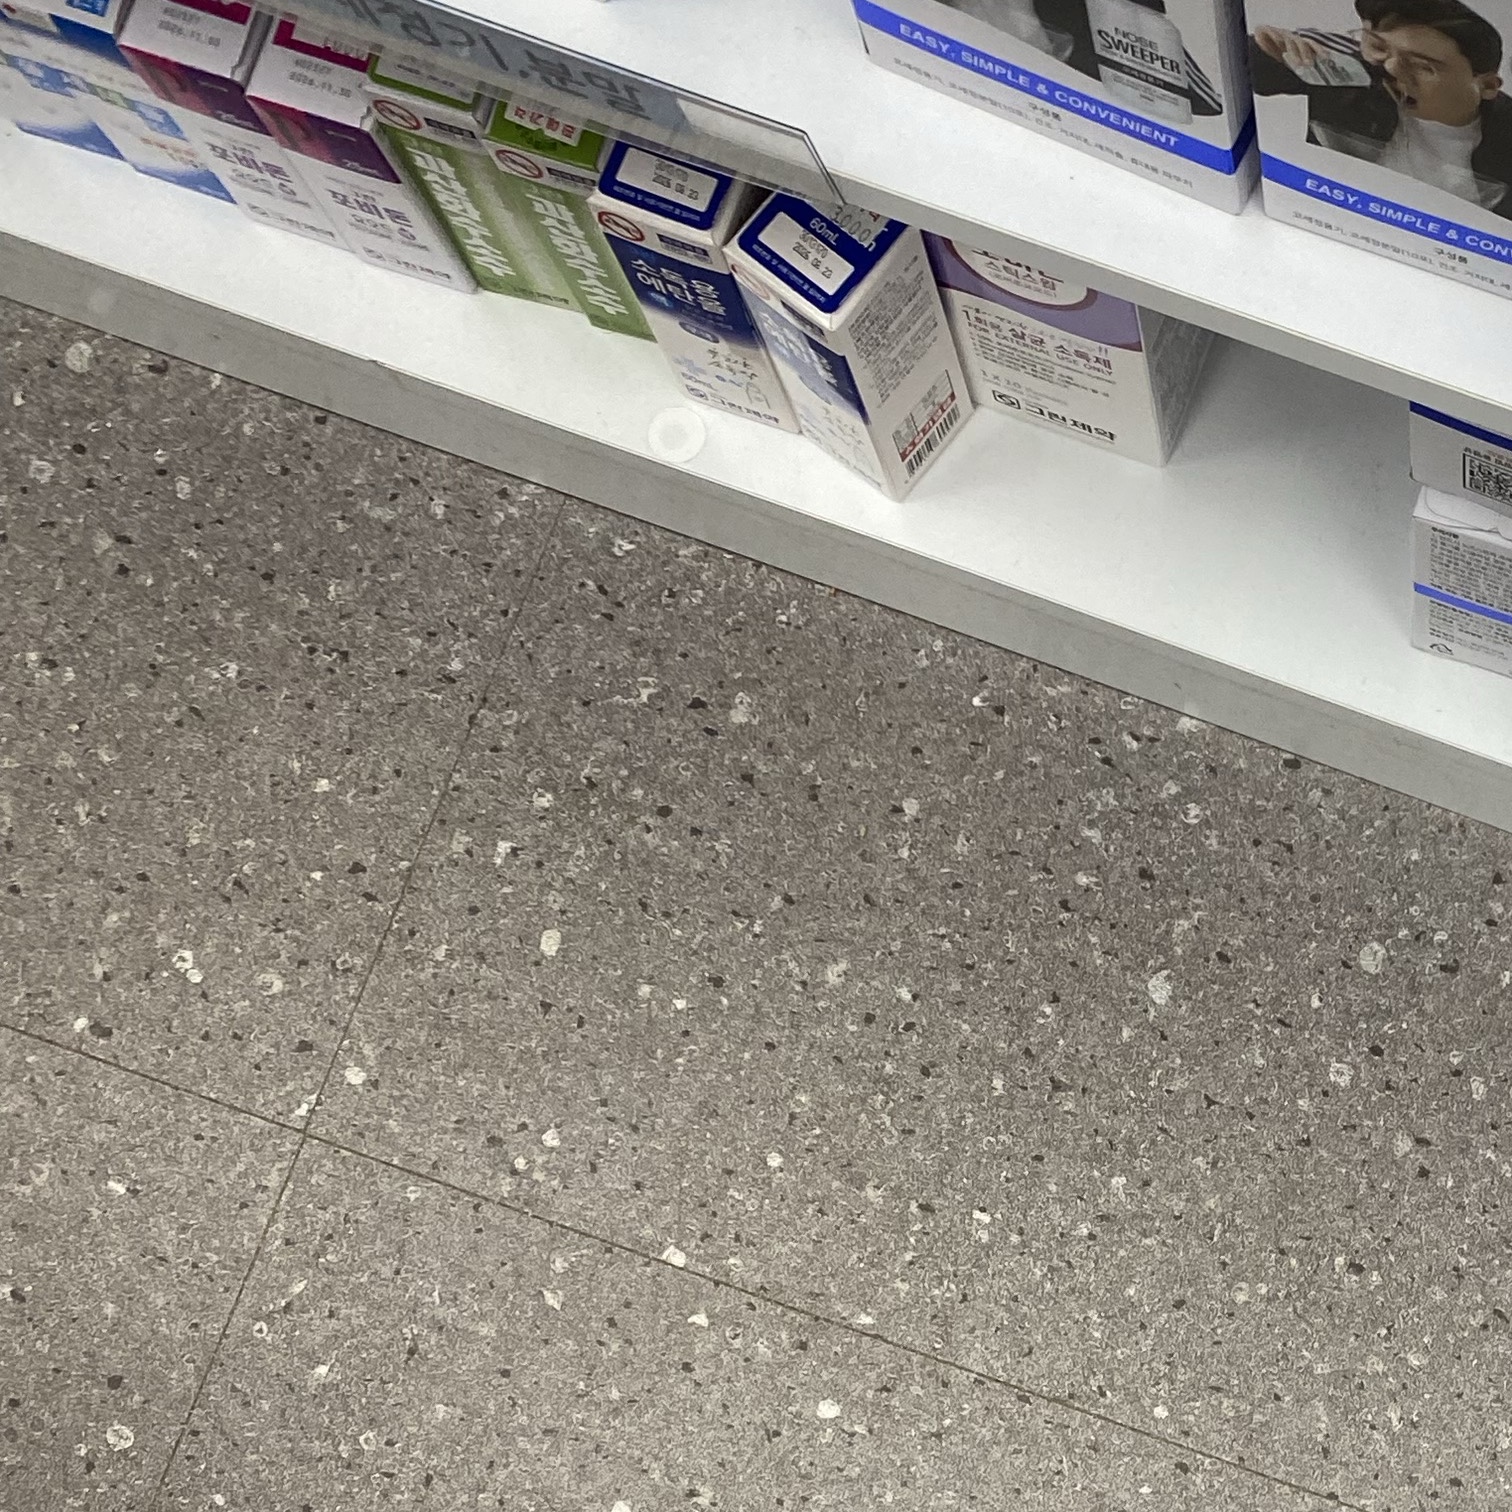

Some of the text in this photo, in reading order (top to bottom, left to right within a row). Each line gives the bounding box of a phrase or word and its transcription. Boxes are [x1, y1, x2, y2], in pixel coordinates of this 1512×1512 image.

[1098, 29, 1181, 74] SWEEPER
[1115, 27, 1158, 51] NOSE
[961, 50, 1030, 88] SIMPLE
[1036, 82, 1049, 95] &
[1055, 89, 1179, 147] CONVENIENT
[326, 189, 412, 228] 포비돈
[1369, 202, 1440, 233] SIMPLE
[1446, 229, 1458, 240] &
[809, 217, 840, 246] 60mL
[631, 259, 719, 298] 소독용
[636, 272, 726, 316] 에탄올
[968, 321, 1113, 376] FOR EXTERNAL USE ONLY
[1009, 327, 1046, 349] 살균
[1054, 344, 1112, 370] 소독제
[1024, 403, 1116, 442] 그린제약
